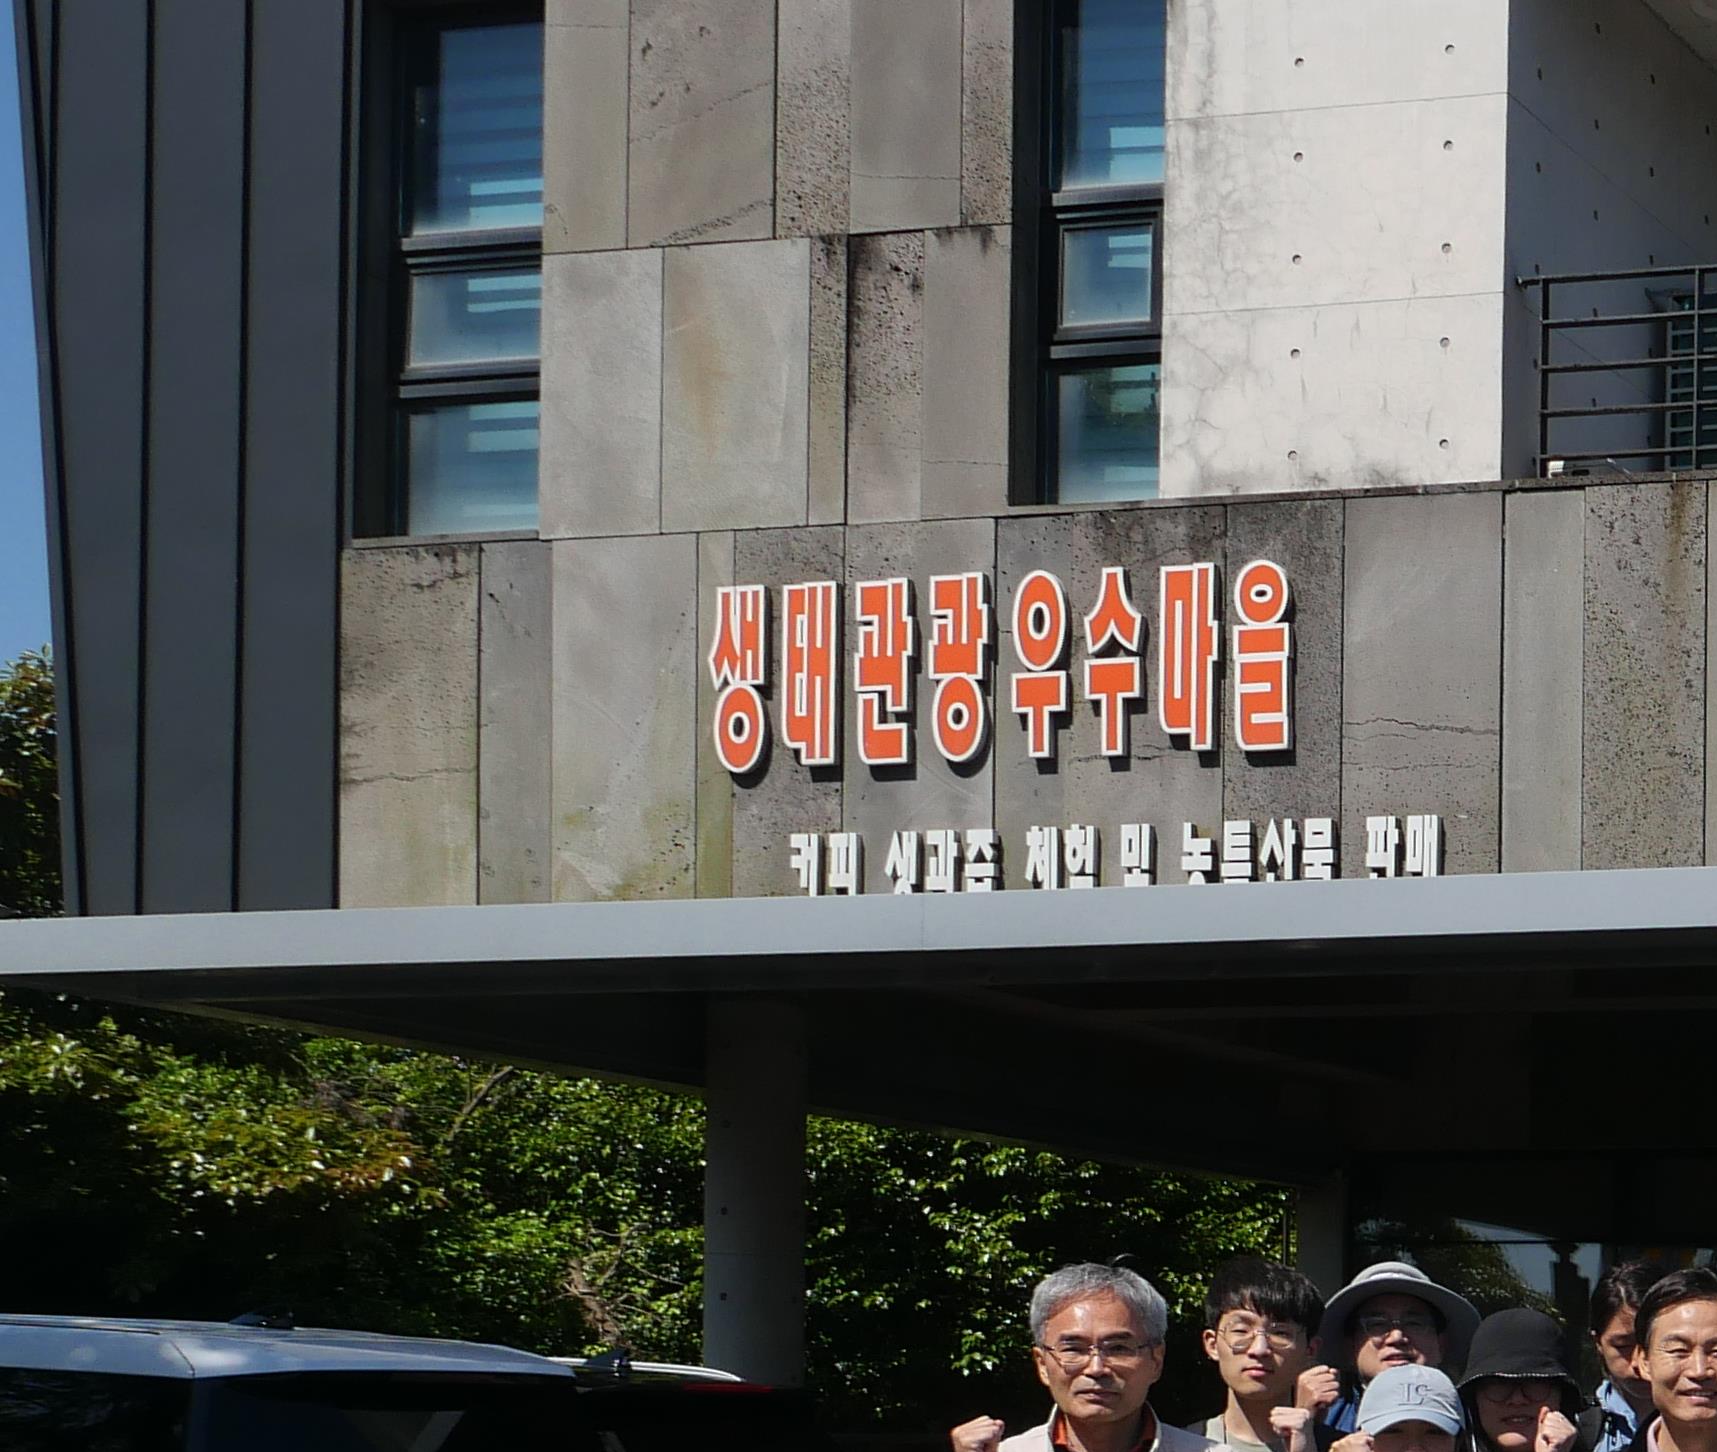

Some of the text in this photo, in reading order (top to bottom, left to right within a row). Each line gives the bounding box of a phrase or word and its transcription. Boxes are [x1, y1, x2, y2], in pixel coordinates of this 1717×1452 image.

[709, 558, 1295, 775] 생태관광우수마을
[790, 832, 863, 897] 커피
[885, 829, 1000, 895] 생과즙
[1025, 824, 1100, 891] 체험
[1182, 817, 1338, 886] 농특산물
[1366, 814, 1442, 879] 판매
